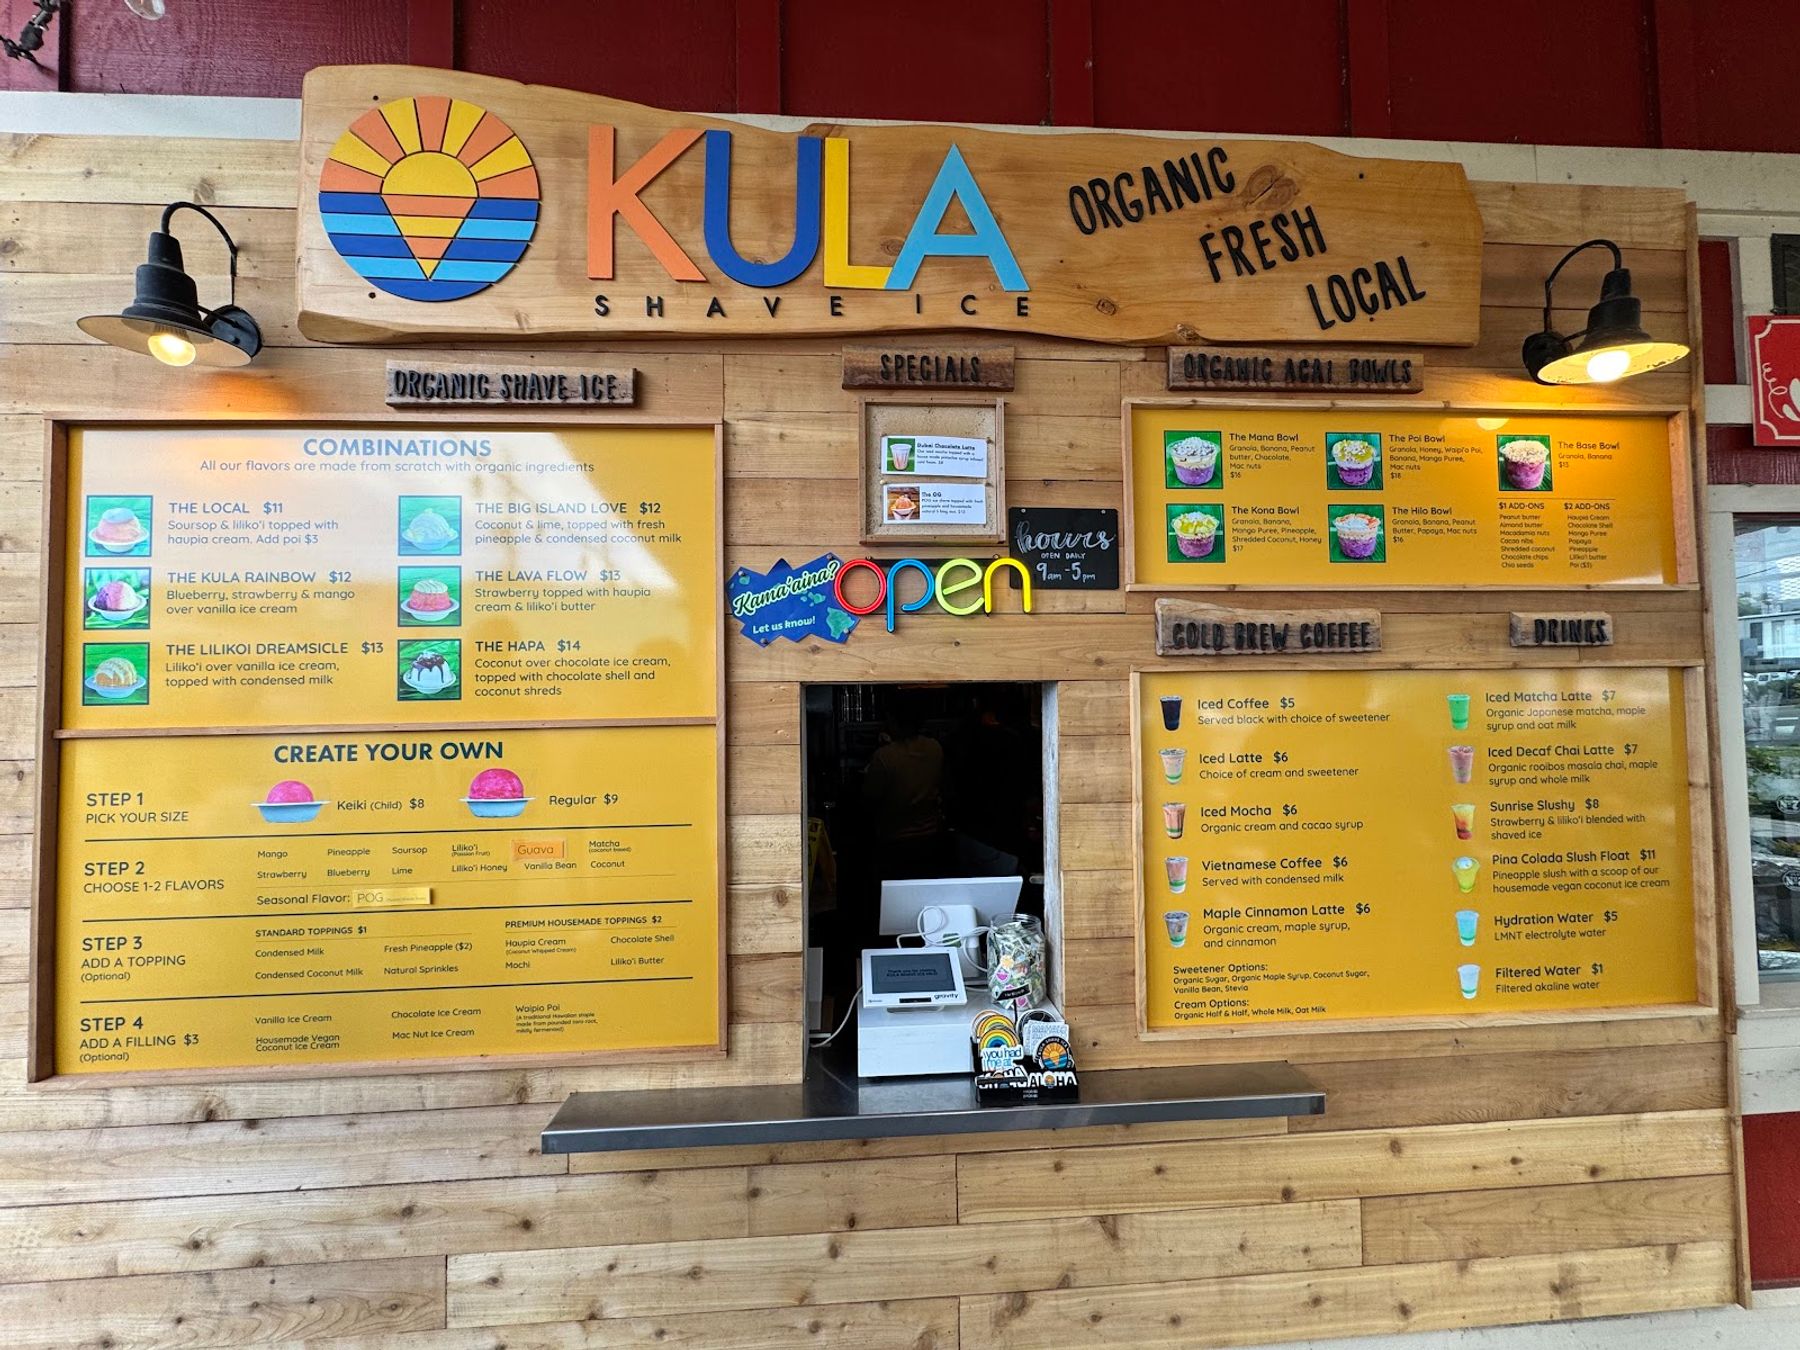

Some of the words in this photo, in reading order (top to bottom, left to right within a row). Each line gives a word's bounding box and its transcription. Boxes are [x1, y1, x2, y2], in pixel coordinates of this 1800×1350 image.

[1069, 146, 1236, 235] ORGANIC
[587, 125, 1029, 291] KULA
[1199, 205, 1327, 283] FRESH
[1305, 255, 1427, 330] LOCAL
[595, 295, 843, 317] SHAVE
[915, 294, 1029, 317] ICE
[881, 354, 981, 382] SPECIALS
[1184, 353, 1272, 382] ORGANIC
[1349, 359, 1412, 383] BOWLS
[394, 370, 490, 400] ORGANIC
[500, 373, 568, 400] SHAVE
[580, 374, 618, 400] ICE
[1228, 432, 1246, 441] The
[1248, 433, 1274, 441] Mana
[1276, 433, 1298, 442] Bowl
[1388, 434, 1406, 442] The
[1407, 434, 1422, 442] Poi
[1423, 434, 1446, 443] Bowl
[303, 438, 492, 458] COMBINATIONS
[1557, 441, 1574, 449] The
[1575, 441, 1597, 449] Base
[1598, 441, 1620, 450] Bowl
[168, 502, 198, 514] THE
[202, 502, 250, 514] LOCAL
[263, 501, 282, 515] $11
[475, 502, 503, 514] THE
[508, 502, 531, 514] BIG
[533, 502, 586, 514] ISLAND
[591, 503, 627, 513] LOVE
[639, 501, 661, 515] $12
[1230, 505, 1249, 514] The
[1250, 506, 1275, 514] Kona
[1277, 506, 1299, 514] Bowl
[1391, 506, 1409, 515] The
[1410, 506, 1429, 515] Hilo
[1430, 506, 1452, 515] Bowl
[1015, 520, 1116, 554] hours
[167, 572, 197, 583] THE
[201, 572, 240, 583] KULA
[244, 571, 316, 583] RAINBOW
[328, 570, 352, 585] $12
[476, 571, 504, 581] THE
[508, 570, 542, 581] LAVA
[547, 570, 587, 581] FLOW
[599, 569, 620, 582] $13
[835, 557, 1032, 633] open
[753, 625, 769, 634] Let
[771, 622, 783, 630] us
[784, 616, 816, 629] know!
[1534, 618, 1608, 645] DRINKS
[1172, 623, 1224, 651] COLD
[1235, 623, 1290, 651] BREW
[1300, 622, 1371, 649] COFFEE
[165, 644, 196, 655] THE
[200, 643, 251, 655] LILIKOI
[256, 642, 348, 654] DREAMSICLE
[361, 641, 384, 654] $13
[474, 640, 503, 652] THE
[507, 640, 545, 651] HAPA
[557, 639, 581, 652] $14
[1197, 698, 1223, 710] Iced
[1227, 697, 1269, 709] Coffee
[1280, 696, 1295, 709] $5
[1485, 691, 1510, 703] Iced
[1513, 691, 1558, 702] Matcha
[1560, 691, 1593, 702] Latte
[1602, 689, 1616, 702] $7
[274, 744, 358, 763] CREATE
[364, 743, 433, 761] YOUR
[439, 741, 503, 759] OWN
[1199, 752, 1225, 764] Iced
[1229, 753, 1262, 763] Latte
[1273, 750, 1288, 763] $6
[1487, 746, 1513, 757] Iced
[1516, 745, 1552, 757] Decaf
[1554, 745, 1580, 756] Chai
[1583, 745, 1614, 755] Latte
[1624, 743, 1638, 755] $7
[86, 792, 131, 807] STEP
[136, 792, 143, 805] 1
[337, 799, 367, 810] Keiki
[369, 801, 403, 811] (Child)
[409, 797, 425, 810] $8
[549, 794, 597, 807] Regular
[603, 793, 618, 805] $9
[1489, 800, 1534, 812] Sunrise
[1536, 799, 1575, 812] Slushy
[1584, 798, 1600, 810] $8
[1200, 806, 1227, 817] Iced
[1230, 805, 1272, 816] Mocha
[1282, 803, 1297, 816] $6
[85, 813, 116, 824] PICK
[119, 811, 156, 823] YOUR
[160, 811, 189, 822] SIZE
[257, 850, 288, 859] Mango
[327, 848, 371, 857] Pineapple
[391, 846, 428, 855] Soursop
[517, 844, 554, 855] Guava
[1492, 854, 1518, 865] Pina
[1520, 852, 1563, 864] Colada
[1566, 851, 1597, 862] Slush
[1600, 850, 1630, 861] Float
[1639, 848, 1655, 861] $11
[84, 861, 129, 876] STEP
[135, 860, 145, 875] 2
[590, 860, 625, 868] Coconut
[1201, 860, 1276, 871] Vietnamese
[1280, 857, 1322, 869] Coffee
[1332, 855, 1348, 868] $6
[256, 870, 307, 879] Strawberry
[327, 869, 370, 877] Blueberry
[391, 867, 413, 875] Lime
[83, 881, 139, 893] CHOOSE
[143, 880, 161, 892] 1-2
[165, 879, 224, 891] FLAVORS
[1203, 907, 1241, 921] Maple
[1245, 906, 1308, 917] Cinnamon
[1311, 905, 1345, 915] Latte
[1355, 902, 1371, 915] $6
[1494, 914, 1554, 928] Hydration
[1556, 913, 1594, 923] Water
[1603, 910, 1618, 923] $5
[81, 936, 128, 951] STEP
[132, 935, 143, 950] 3
[254, 949, 305, 957] Condensed
[306, 947, 324, 955] Milk
[1495, 966, 1541, 978] Filtered
[1543, 965, 1581, 976] Water
[1591, 962, 1603, 975] $1
[80, 1016, 126, 1032] STEP
[132, 1016, 144, 1029] 4
[79, 1038, 109, 1049] ADD
[112, 1037, 122, 1048] A
[125, 1035, 176, 1047] FILLING
[183, 1033, 199, 1046] $3
[1004, 1048, 1021, 1058] had
